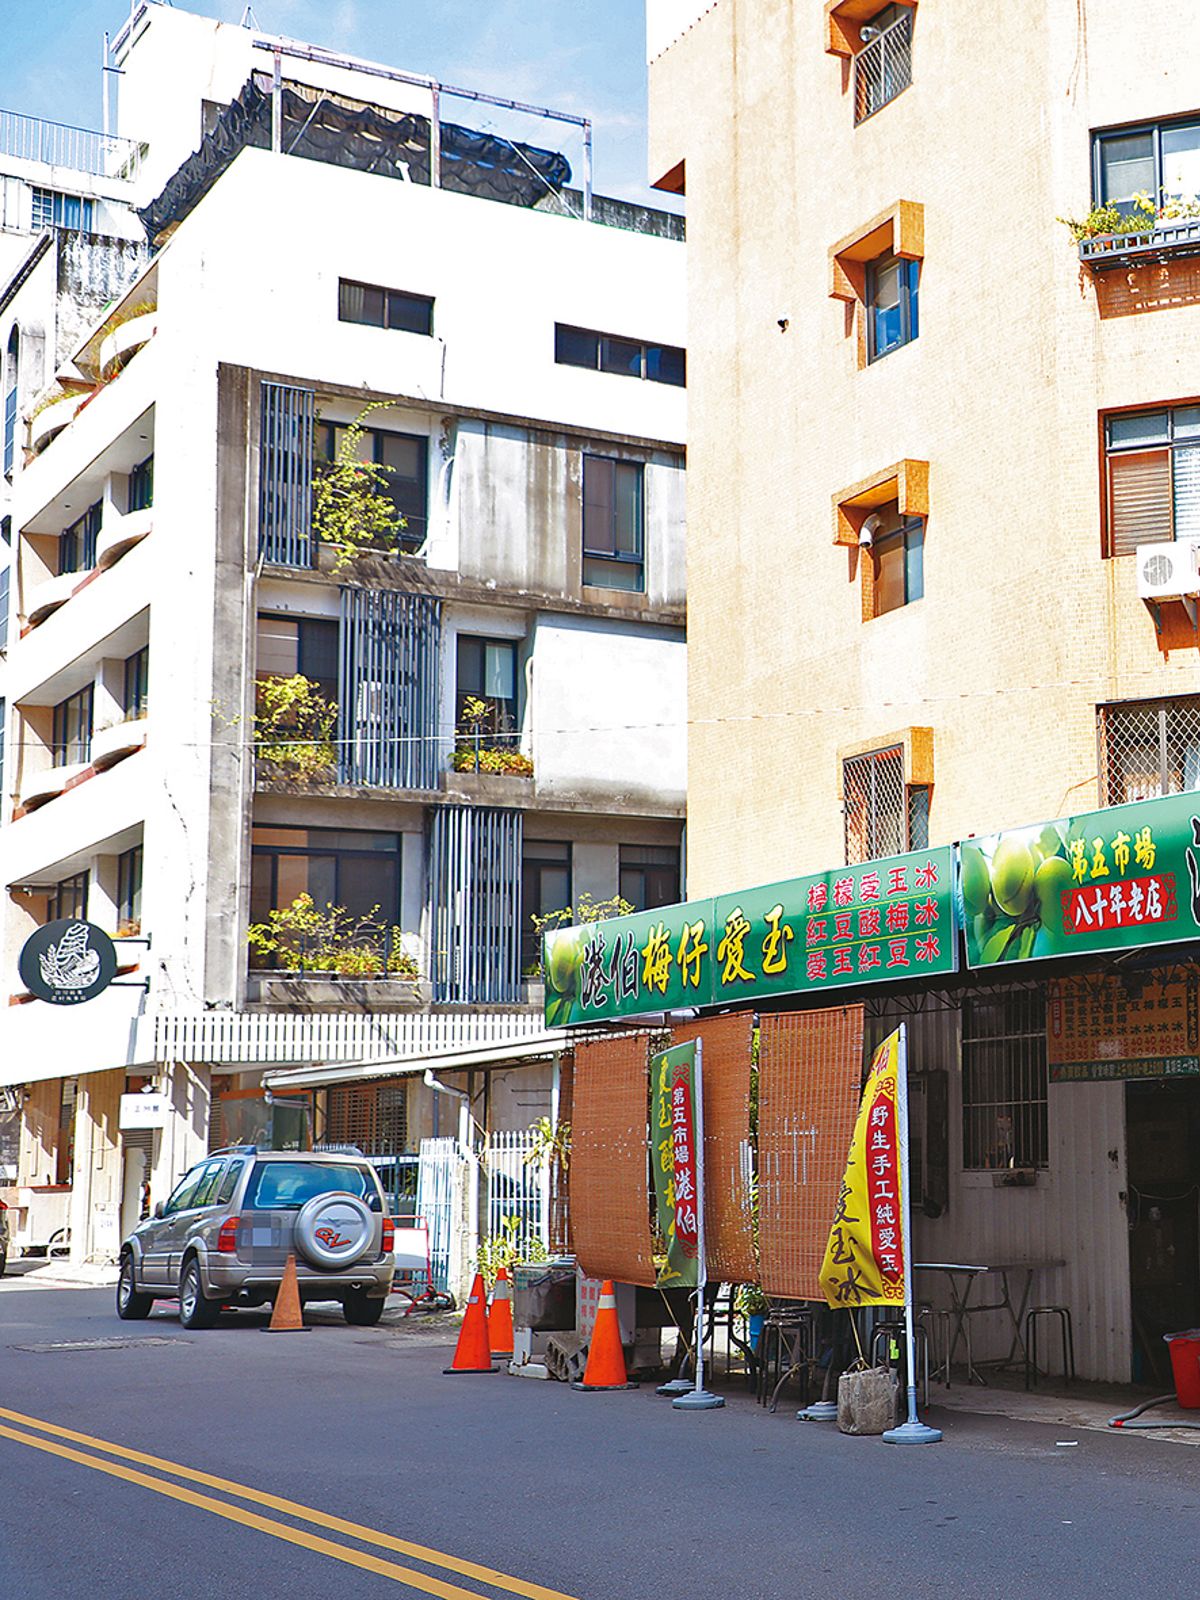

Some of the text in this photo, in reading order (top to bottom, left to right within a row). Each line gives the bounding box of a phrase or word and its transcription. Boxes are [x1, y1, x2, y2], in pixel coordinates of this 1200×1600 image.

[1069, 826, 1157, 884] 第五市場
[807, 861, 938, 912] 檸檬愛玉冰
[1074, 879, 1164, 927] 八十年老店
[806, 898, 939, 947] 紅豆酸梅冰
[805, 932, 940, 981] 愛玉紅豆冰
[870, 1105, 899, 1273] 野生手工純愛玉
